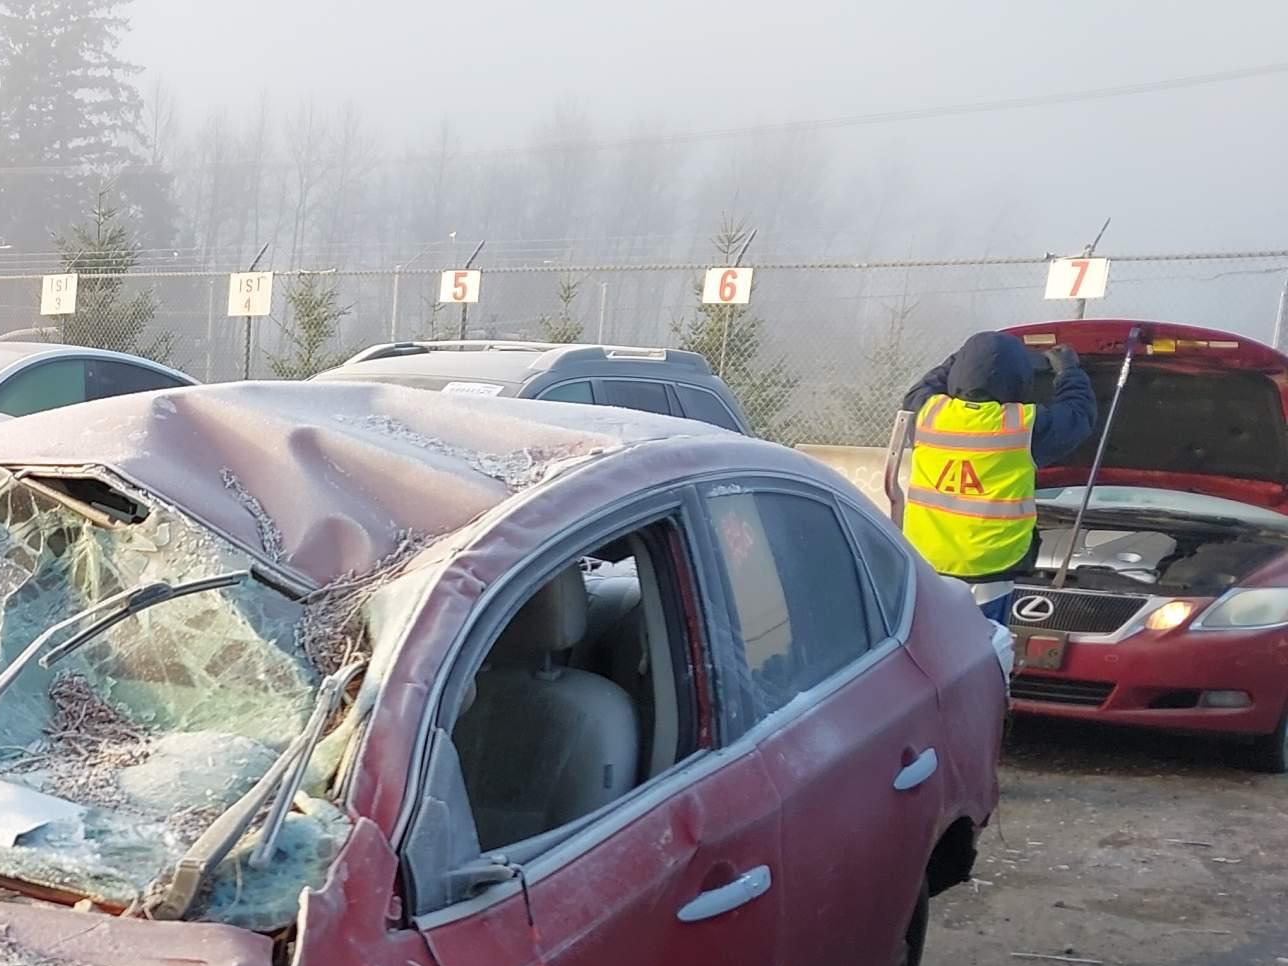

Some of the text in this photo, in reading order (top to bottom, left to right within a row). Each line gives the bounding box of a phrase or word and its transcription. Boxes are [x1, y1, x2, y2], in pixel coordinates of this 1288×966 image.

[452, 271, 468, 301] 5
[719, 269, 738, 302] 6
[1069, 261, 1090, 297] 7
[244, 296, 251, 312] 4
